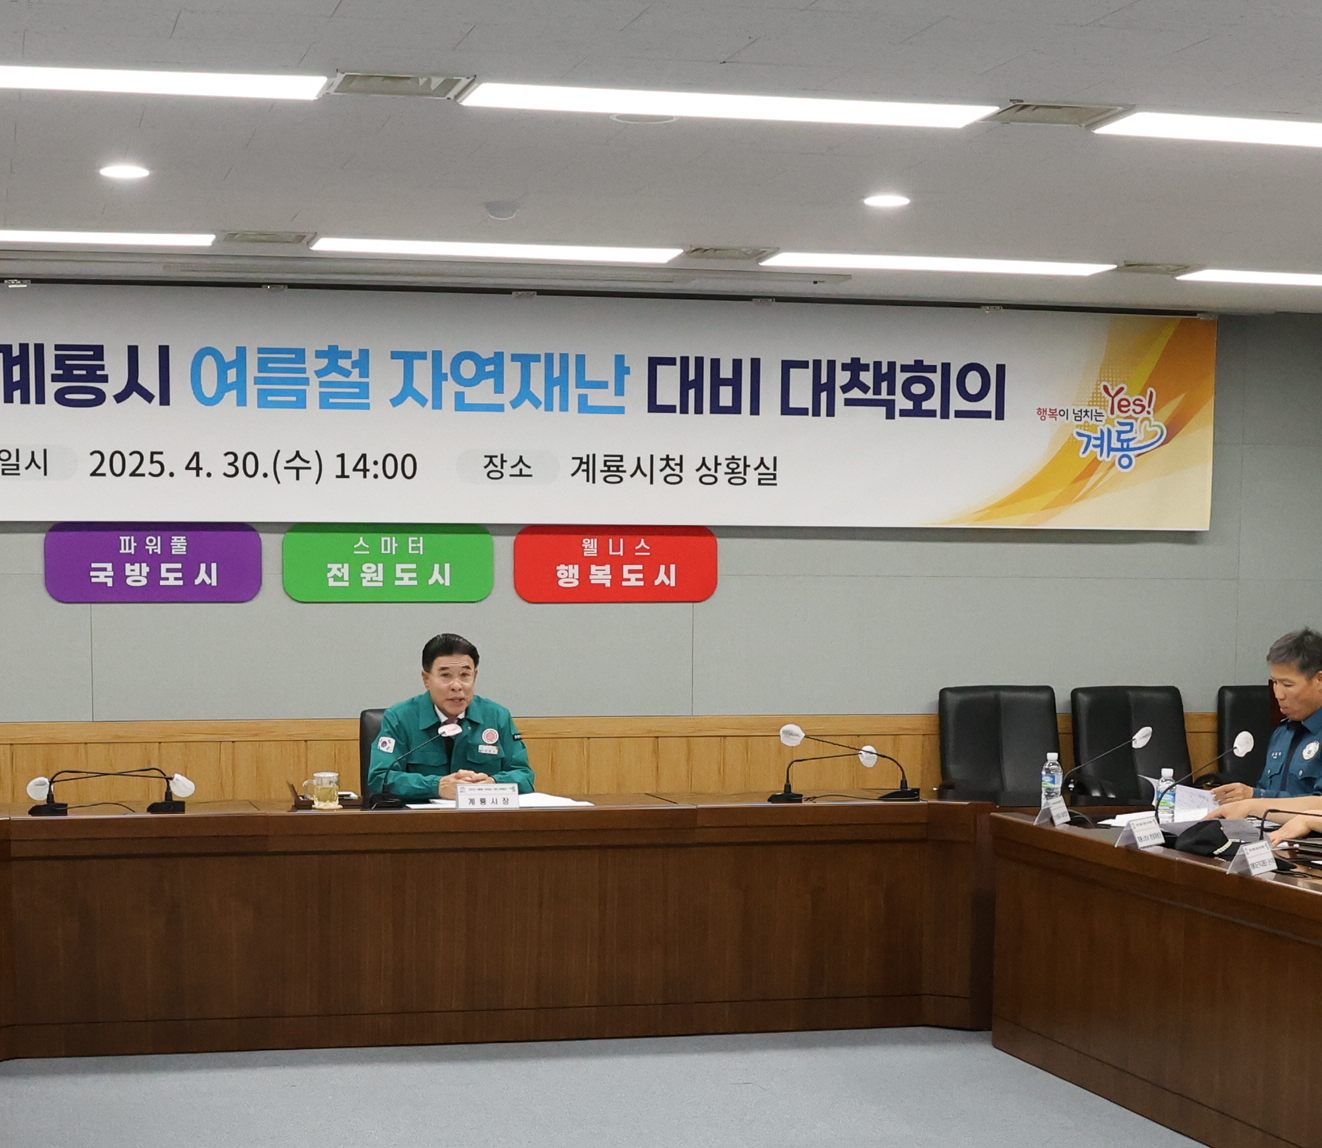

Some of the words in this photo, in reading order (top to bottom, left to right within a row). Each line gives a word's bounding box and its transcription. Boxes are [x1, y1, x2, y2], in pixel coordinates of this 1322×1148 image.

[190, 344, 371, 410] 여름철
[389, 349, 631, 415] 자연재난
[647, 355, 761, 416] 대비
[779, 357, 1006, 421] 대책회의
[1102, 384, 1154, 415] Yes!
[1036, 407, 1069, 421] 행복이
[1072, 408, 1105, 422] 넘치는
[1075, 421, 1160, 470] 계룡
[88, 450, 175, 478] 2025.
[184, 450, 213, 479] 4.
[222, 449, 324, 485] 30.(수)
[335, 451, 418, 480] 14:00
[482, 453, 533, 481] 장소
[570, 453, 686, 486] 계룡시청
[695, 453, 779, 487] 상황실
[119, 536, 188, 555] 파워풀
[353, 536, 425, 555] 스마터
[582, 537, 651, 556] 웰니스
[89, 562, 219, 587] 국방도시
[326, 562, 452, 588] 전원도시
[556, 562, 677, 588] 행복도시
